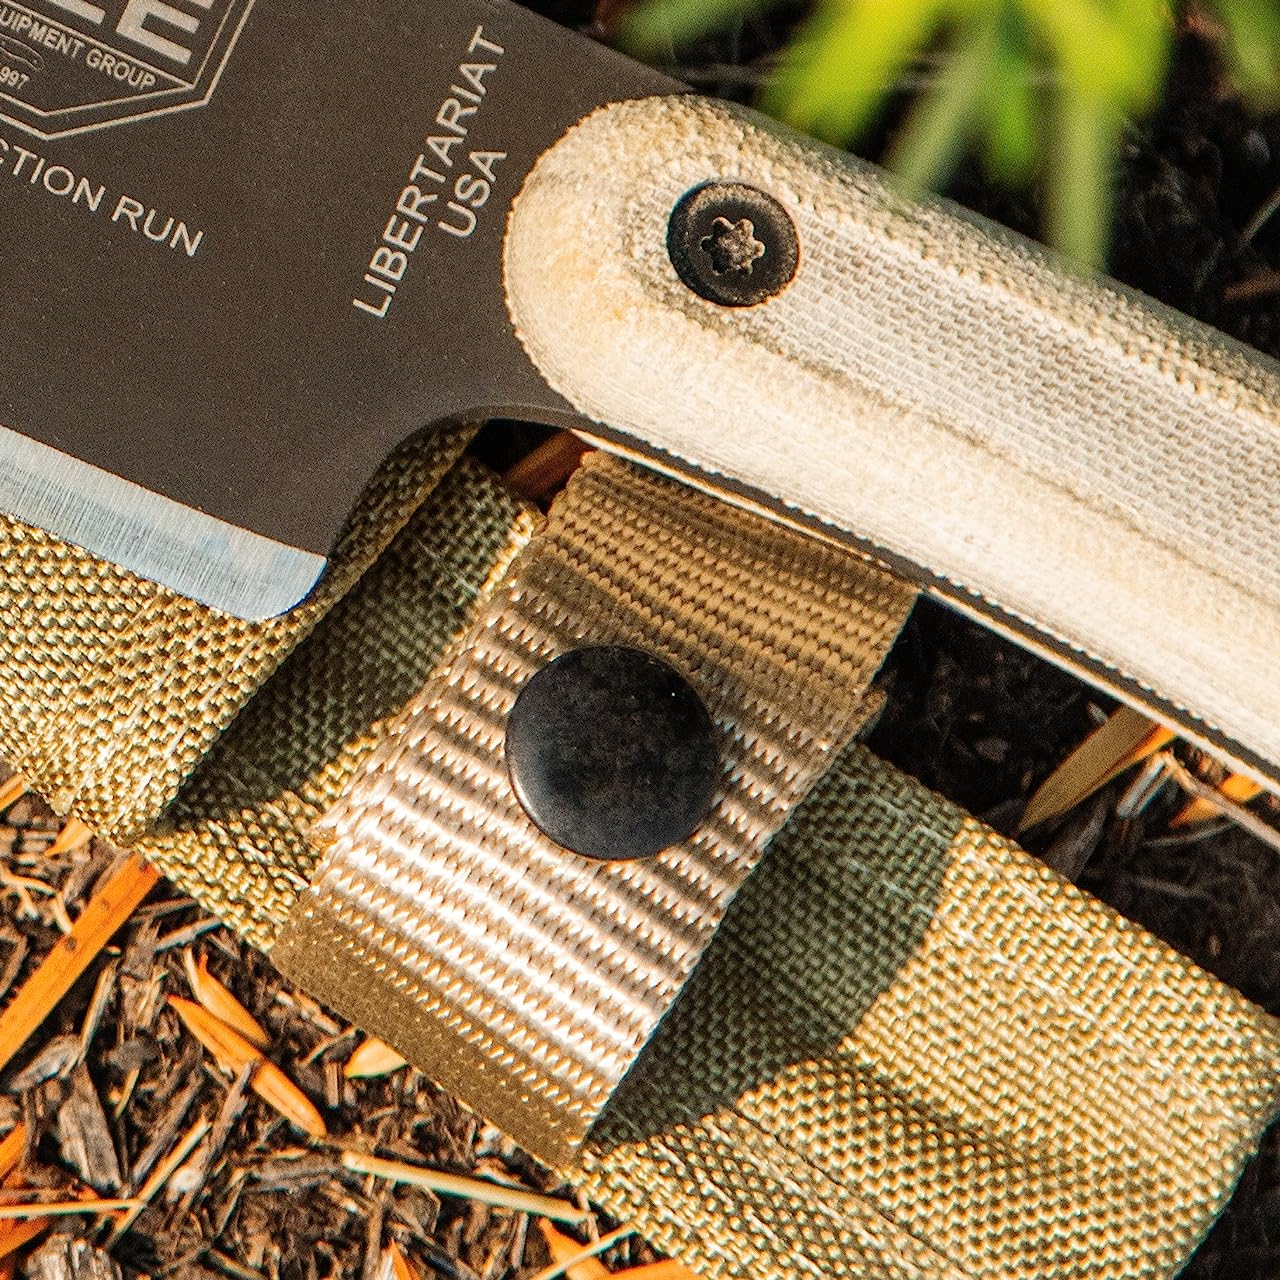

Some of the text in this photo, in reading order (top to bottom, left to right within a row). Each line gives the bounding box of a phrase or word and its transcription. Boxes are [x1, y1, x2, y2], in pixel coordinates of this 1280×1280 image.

[86, 49, 157, 91] GROUP
[352, 24, 506, 318] LIBERTARIAT
[437, 150, 508, 238] USA
[111, 194, 205, 257] RUN
